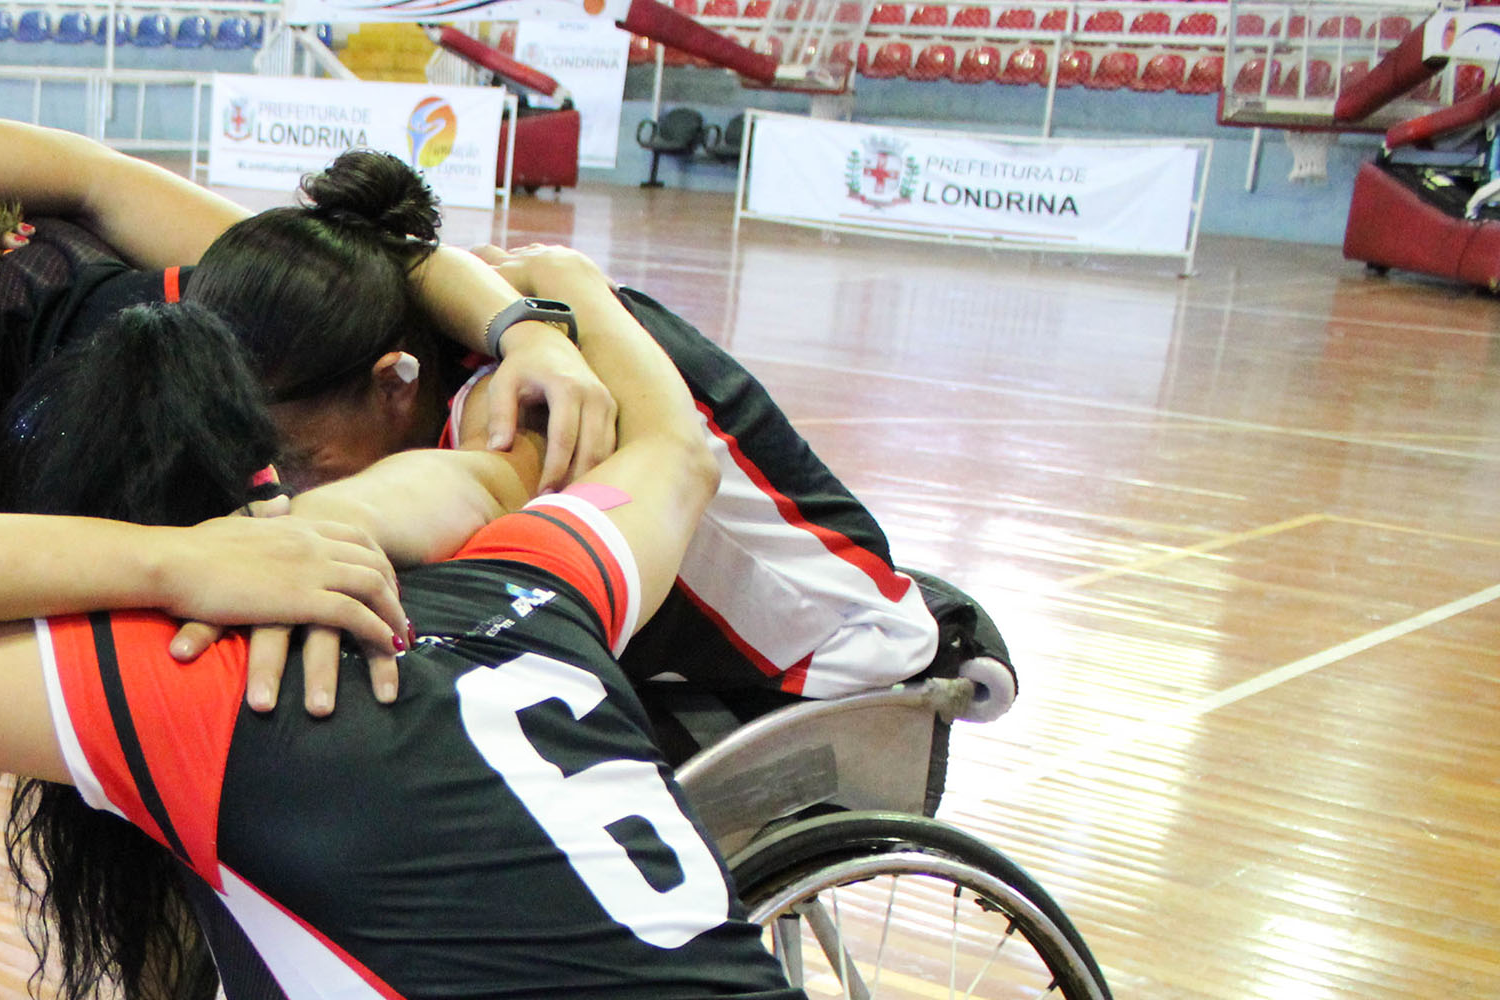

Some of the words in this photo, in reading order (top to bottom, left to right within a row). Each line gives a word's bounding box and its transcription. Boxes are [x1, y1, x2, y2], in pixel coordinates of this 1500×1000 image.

[258, 101, 348, 122] PREFEITURA
[351, 105, 372, 125] DE
[256, 122, 368, 149] LONDRINA
[925, 155, 1053, 181] PREFEITURA
[1059, 167, 1087, 184] DE
[922, 182, 1079, 216] LONDRINA
[456, 652, 729, 949] 6
